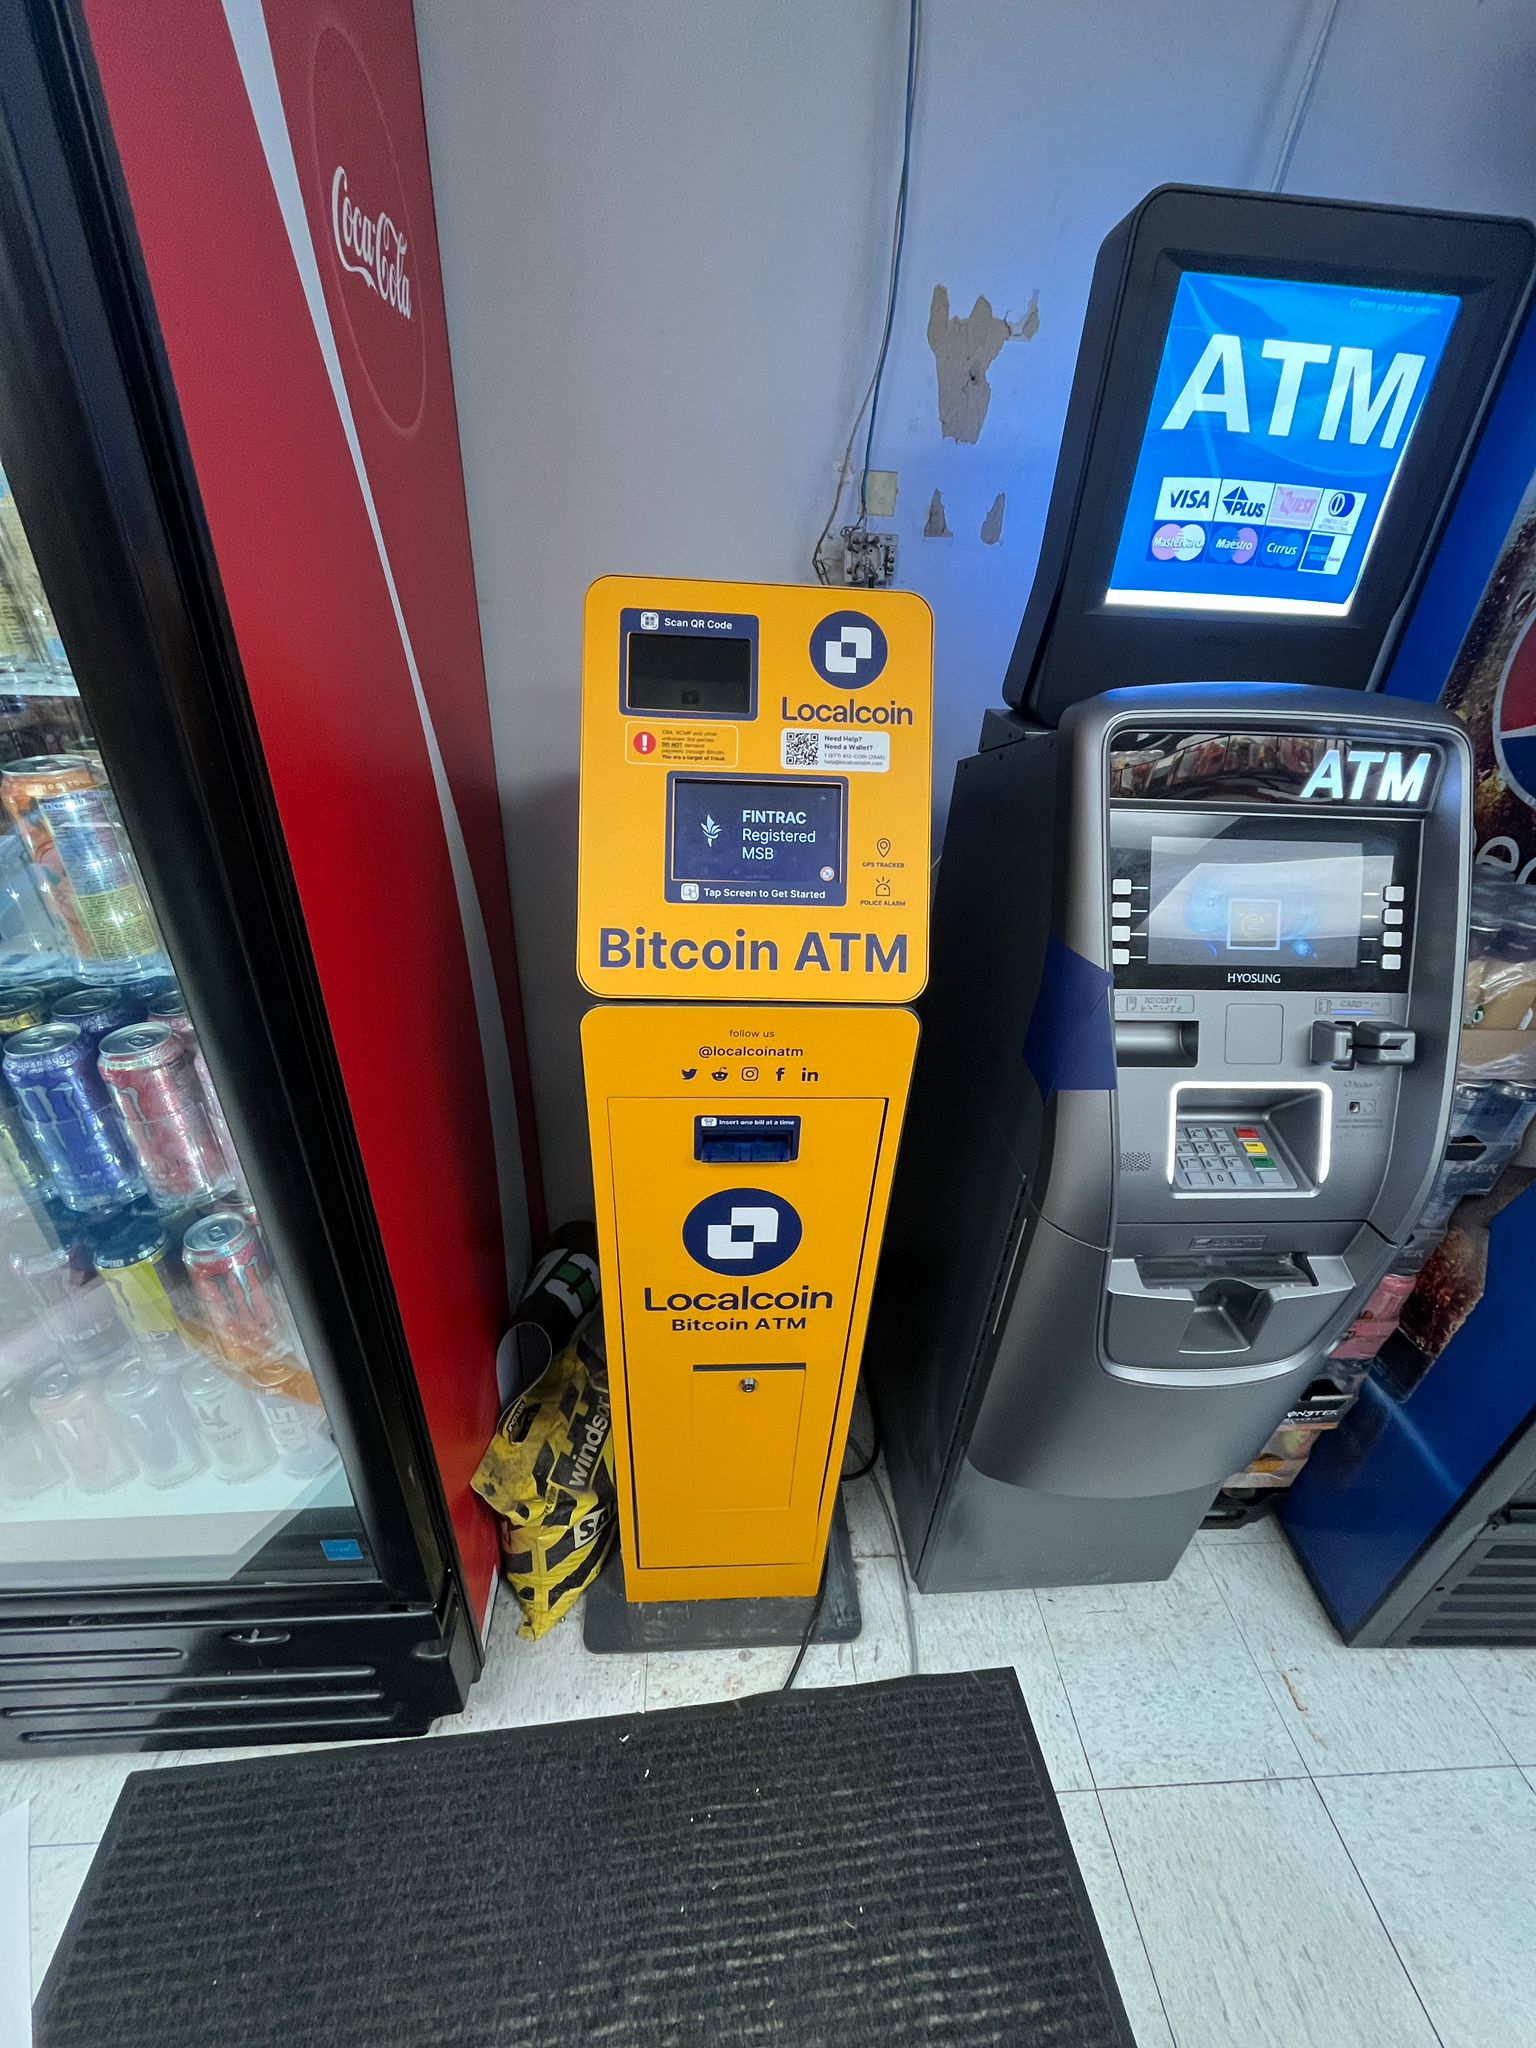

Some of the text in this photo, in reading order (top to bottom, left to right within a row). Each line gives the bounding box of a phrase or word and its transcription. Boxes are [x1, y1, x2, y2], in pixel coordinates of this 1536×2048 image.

[332, 166, 412, 320] Coca-Cola
[1161, 333, 1426, 449] ATM
[1170, 489, 1210, 509] VISA
[1231, 501, 1266, 518] PLUS
[1153, 537, 1203, 548] MasterCard
[1215, 538, 1253, 550] Maestro
[1266, 542, 1298, 555] Cirrus
[664, 617, 733, 630] Scan QR Code
[782, 696, 913, 726] Localcoin
[843, 735, 863, 743] Help?
[1300, 749, 1432, 802] ATM
[742, 809, 807, 825] FINTRAC
[742, 828, 816, 844] Registered
[742, 846, 774, 860] MSB
[703, 887, 826, 899] Tap Screen to Get Started
[599, 926, 908, 974] Bitcoin ATM
[1227, 972, 1281, 984] HYOSUNG
[729, 1029, 775, 1038] follow us
[698, 1045, 804, 1059] @localcoinatm
[1216, 1174, 1224, 1182] 0
[644, 1284, 833, 1312] Localcoin
[672, 1317, 807, 1331] Bitcoin ATM
